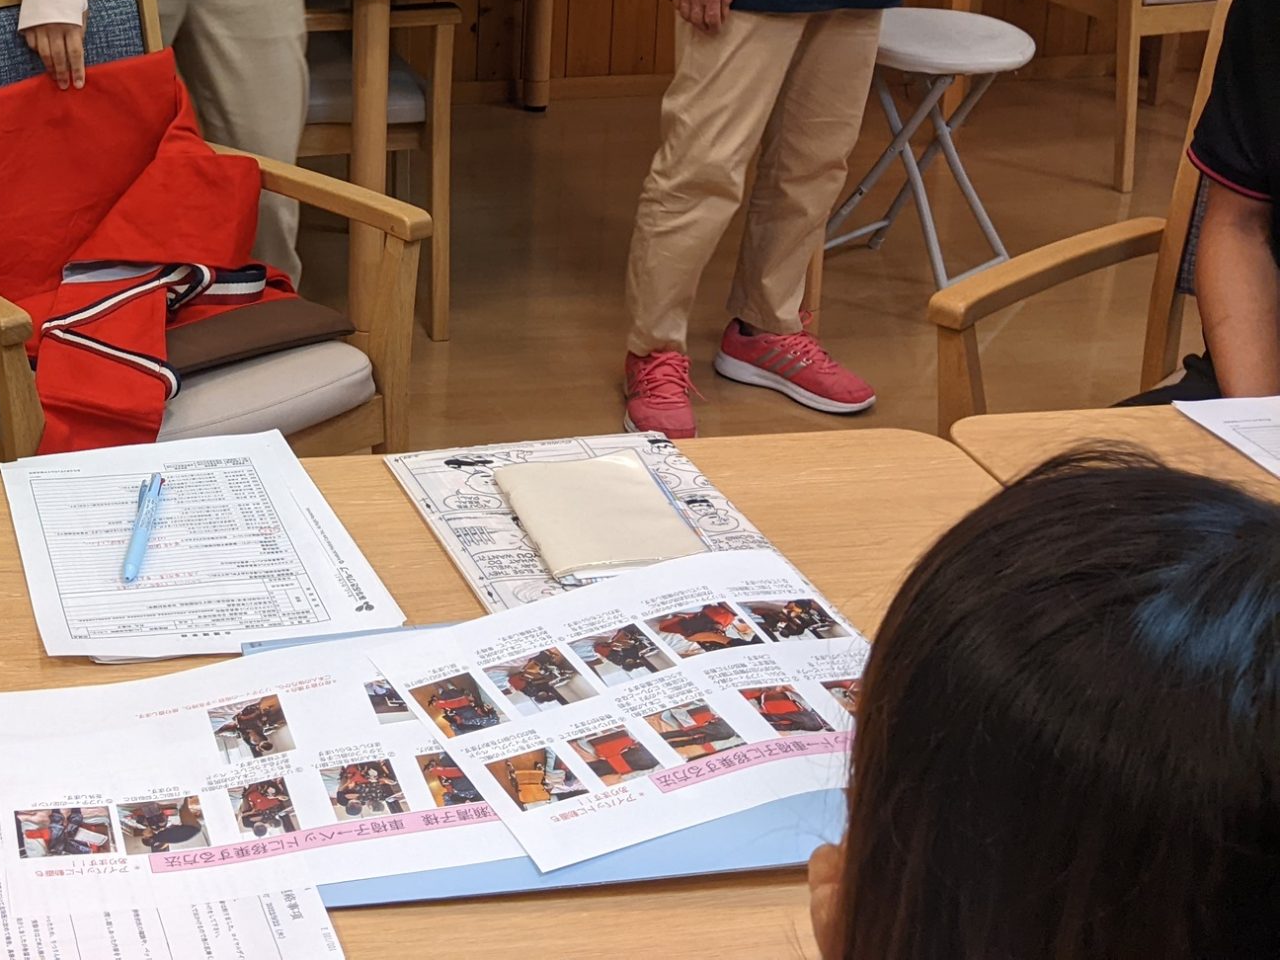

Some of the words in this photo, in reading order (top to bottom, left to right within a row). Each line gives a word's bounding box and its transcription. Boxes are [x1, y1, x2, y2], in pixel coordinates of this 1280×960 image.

[656, 736, 844, 787] ッド→車椅子に移乗する方法
